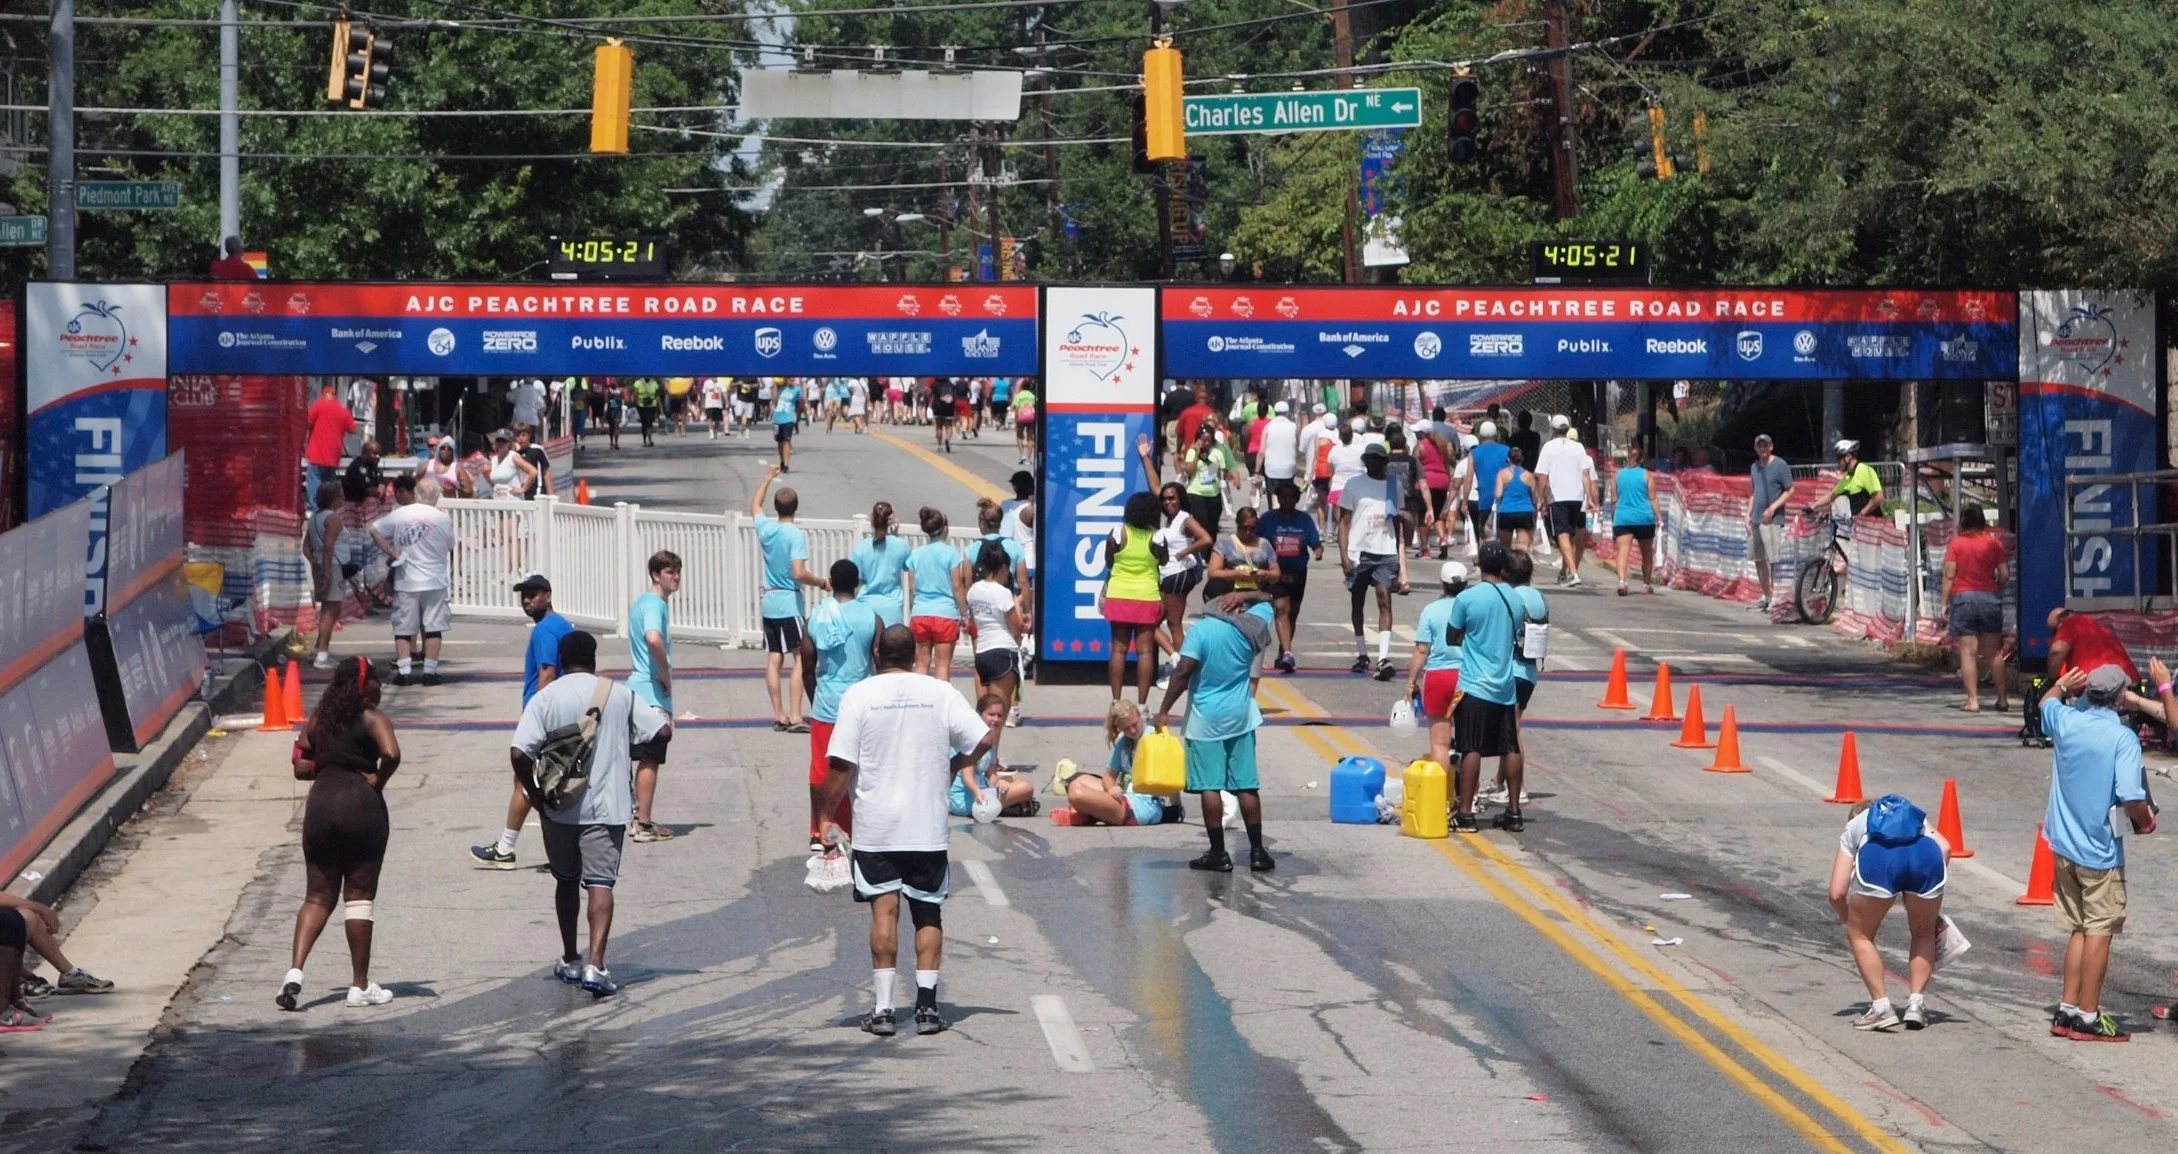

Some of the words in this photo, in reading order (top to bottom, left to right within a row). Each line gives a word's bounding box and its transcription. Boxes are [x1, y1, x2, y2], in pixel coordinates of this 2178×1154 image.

[1366, 94, 1382, 108] NE
[1185, 103, 1264, 128] Charles
[1273, 100, 1324, 125] Allen
[1334, 98, 1358, 122] Dr
[79, 186, 132, 204] Piedmont
[135, 186, 161, 204] Park
[161, 183, 177, 193] AVE
[0, 222, 25, 240] llen
[31, 219, 43, 229] DR
[31, 230, 43, 240] NE
[406, 296, 454, 312] AJC
[468, 296, 630, 312] PEACHTREE
[644, 296, 718, 313] ROAD
[731, 297, 804, 313] RACE
[1393, 300, 1441, 316] AJC
[1456, 300, 1615, 316] PEACHTREE
[1629, 300, 1701, 317] ROAD
[1715, 301, 1785, 317] RACE
[60, 334, 119, 342] Peachtree
[331, 328, 355, 338] Bank
[355, 328, 366, 338] of
[365, 328, 403, 338] America
[868, 332, 931, 343] WAFFLE
[1319, 332, 1342, 342] Bank
[1342, 332, 1353, 342] of
[1352, 332, 1389, 342] America
[1470, 334, 1523, 342] POWERADE
[483, 337, 538, 351] ZERO
[661, 335, 724, 350] Reebok
[757, 335, 780, 353] ups
[872, 343, 926, 353] HOUSE
[1059, 344, 1120, 352] Peachtree
[1470, 341, 1523, 354] ZERO
[1646, 338, 1707, 353] Reebok
[1739, 339, 1761, 357] ups
[1074, 422, 1125, 620] FINISH
